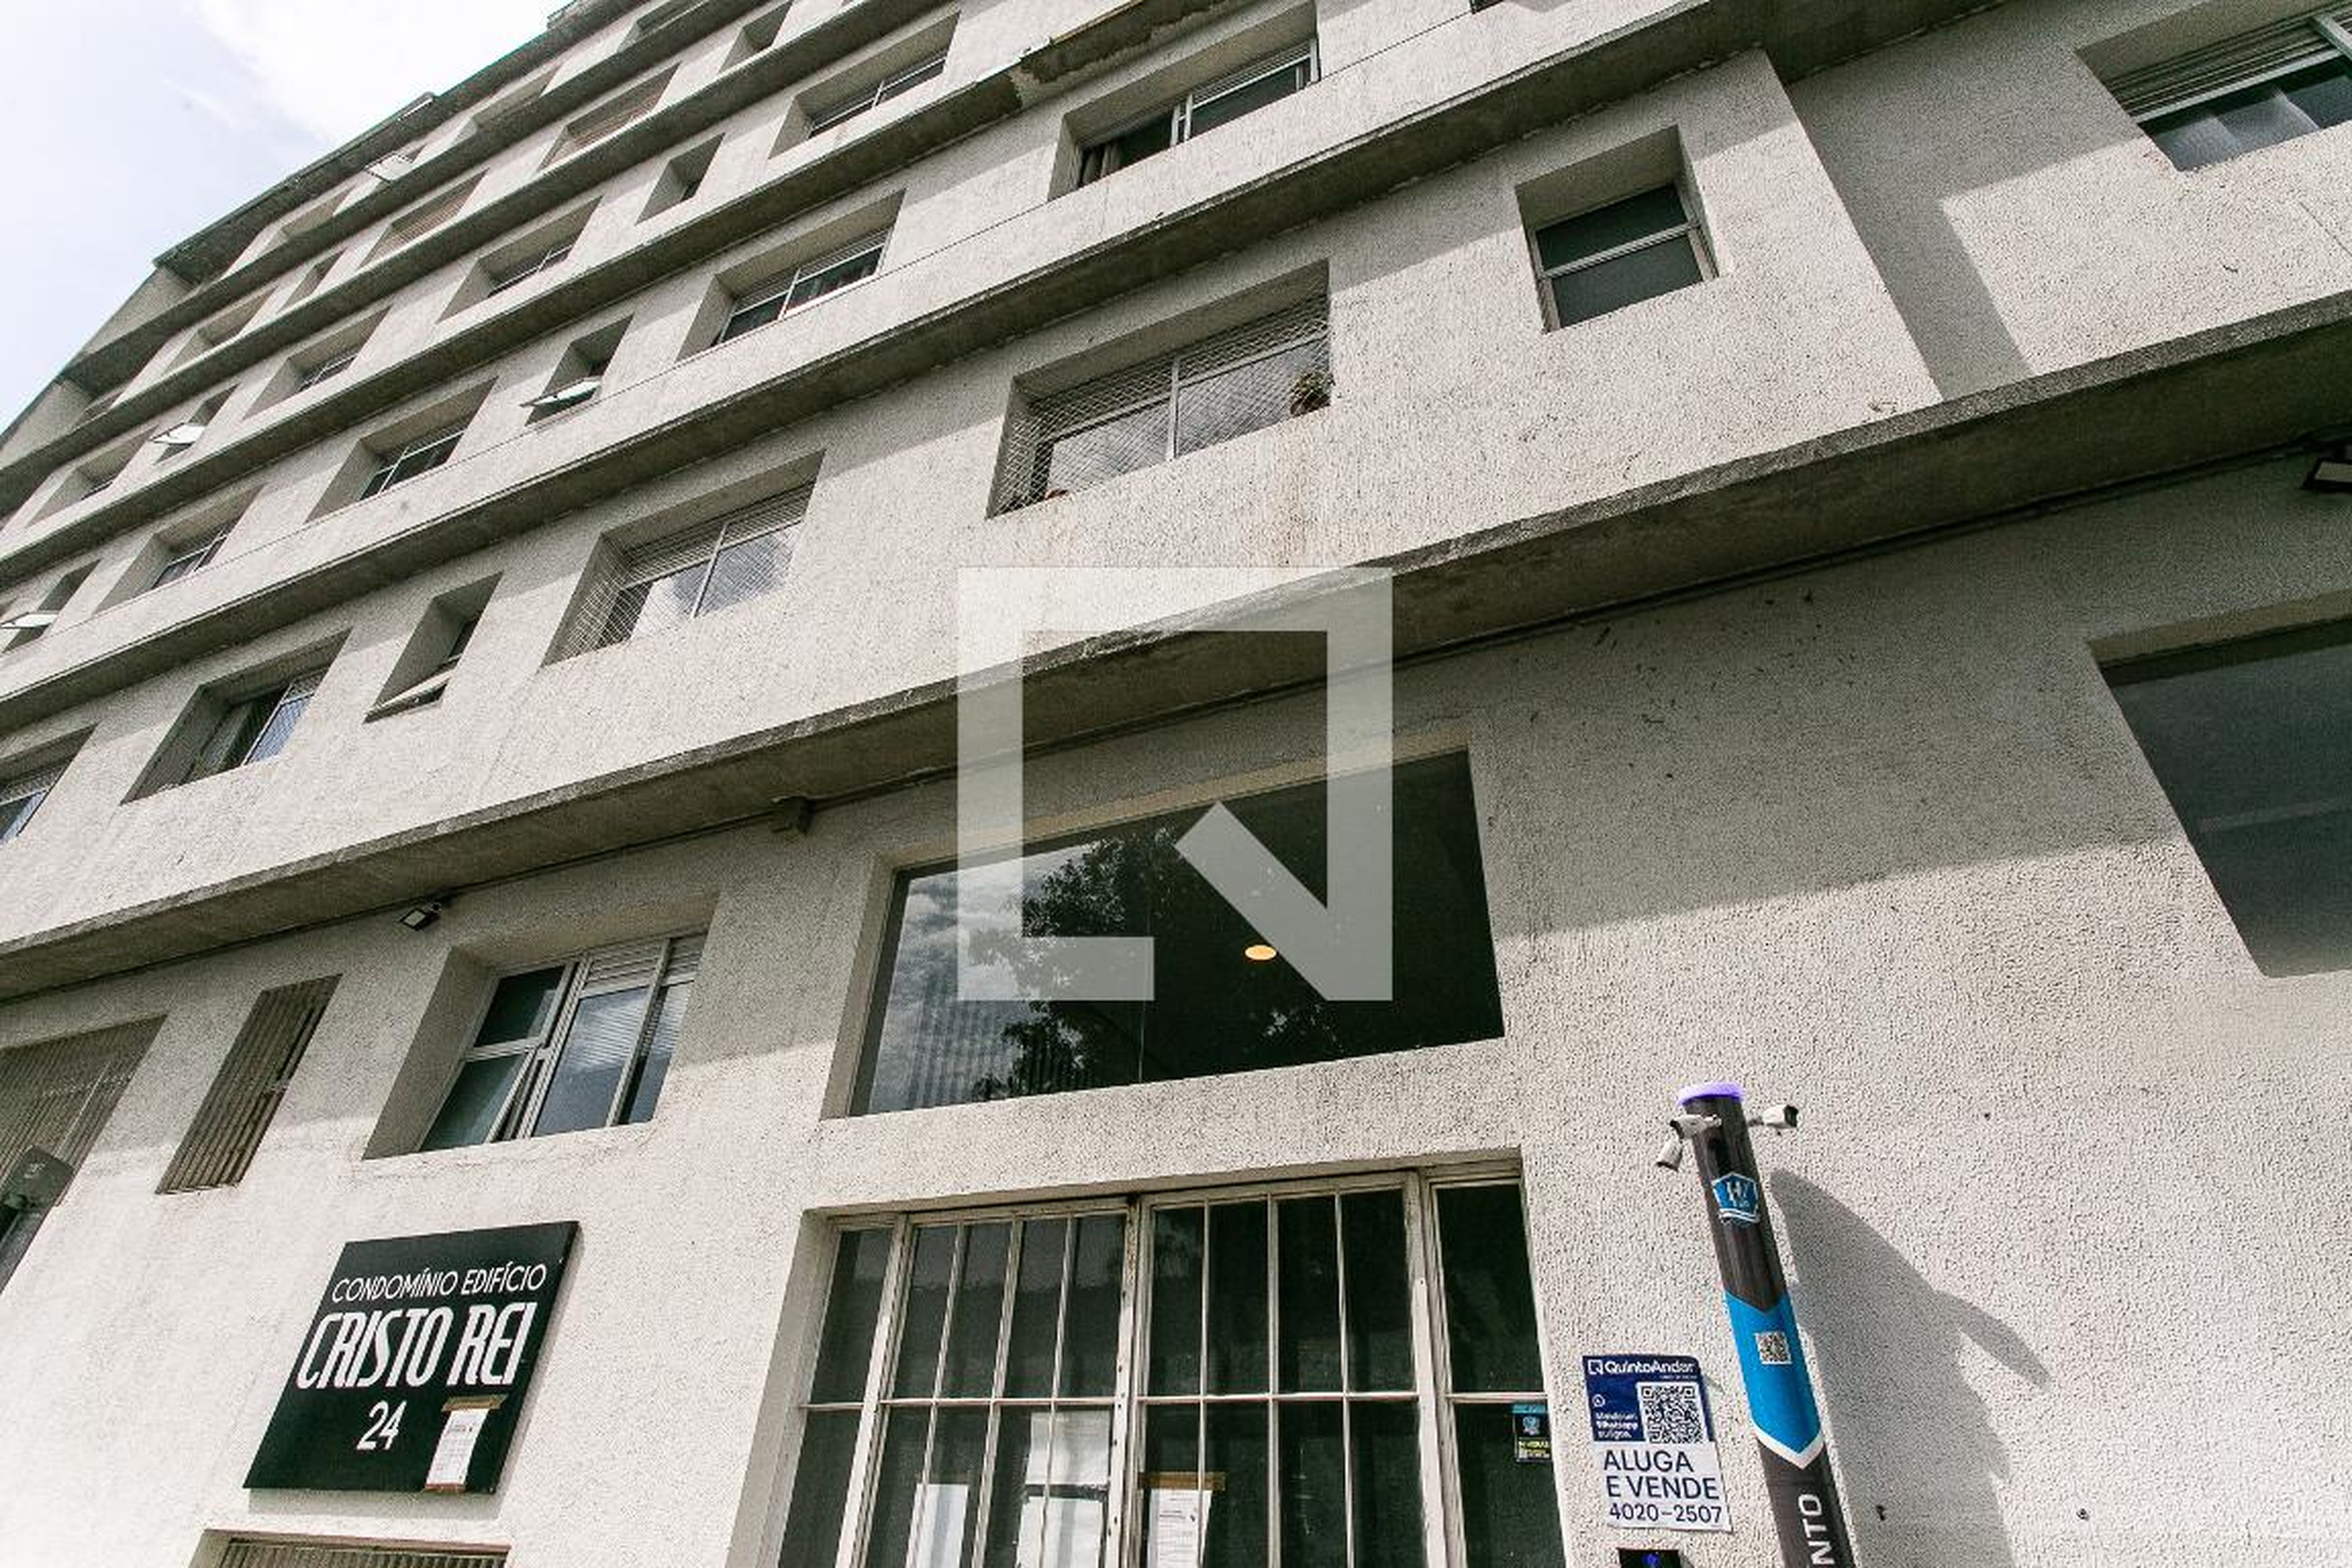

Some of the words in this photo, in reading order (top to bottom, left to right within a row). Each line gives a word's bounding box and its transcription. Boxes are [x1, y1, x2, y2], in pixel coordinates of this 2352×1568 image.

[331, 1268, 458, 1303] CONDOMÍNIO
[461, 1262, 546, 1295] EDIFÍCIO
[296, 1306, 454, 1389] CRISTO
[447, 1302, 537, 1385] REI
[356, 1400, 407, 1450] 24
[1604, 1449, 1694, 1472] ALUGA
[1607, 1476, 1621, 1498] E
[1626, 1476, 1719, 1500] VENDE
[1610, 1503, 1722, 1523] 4020-2507
[1798, 1494, 1835, 1568] NTO
